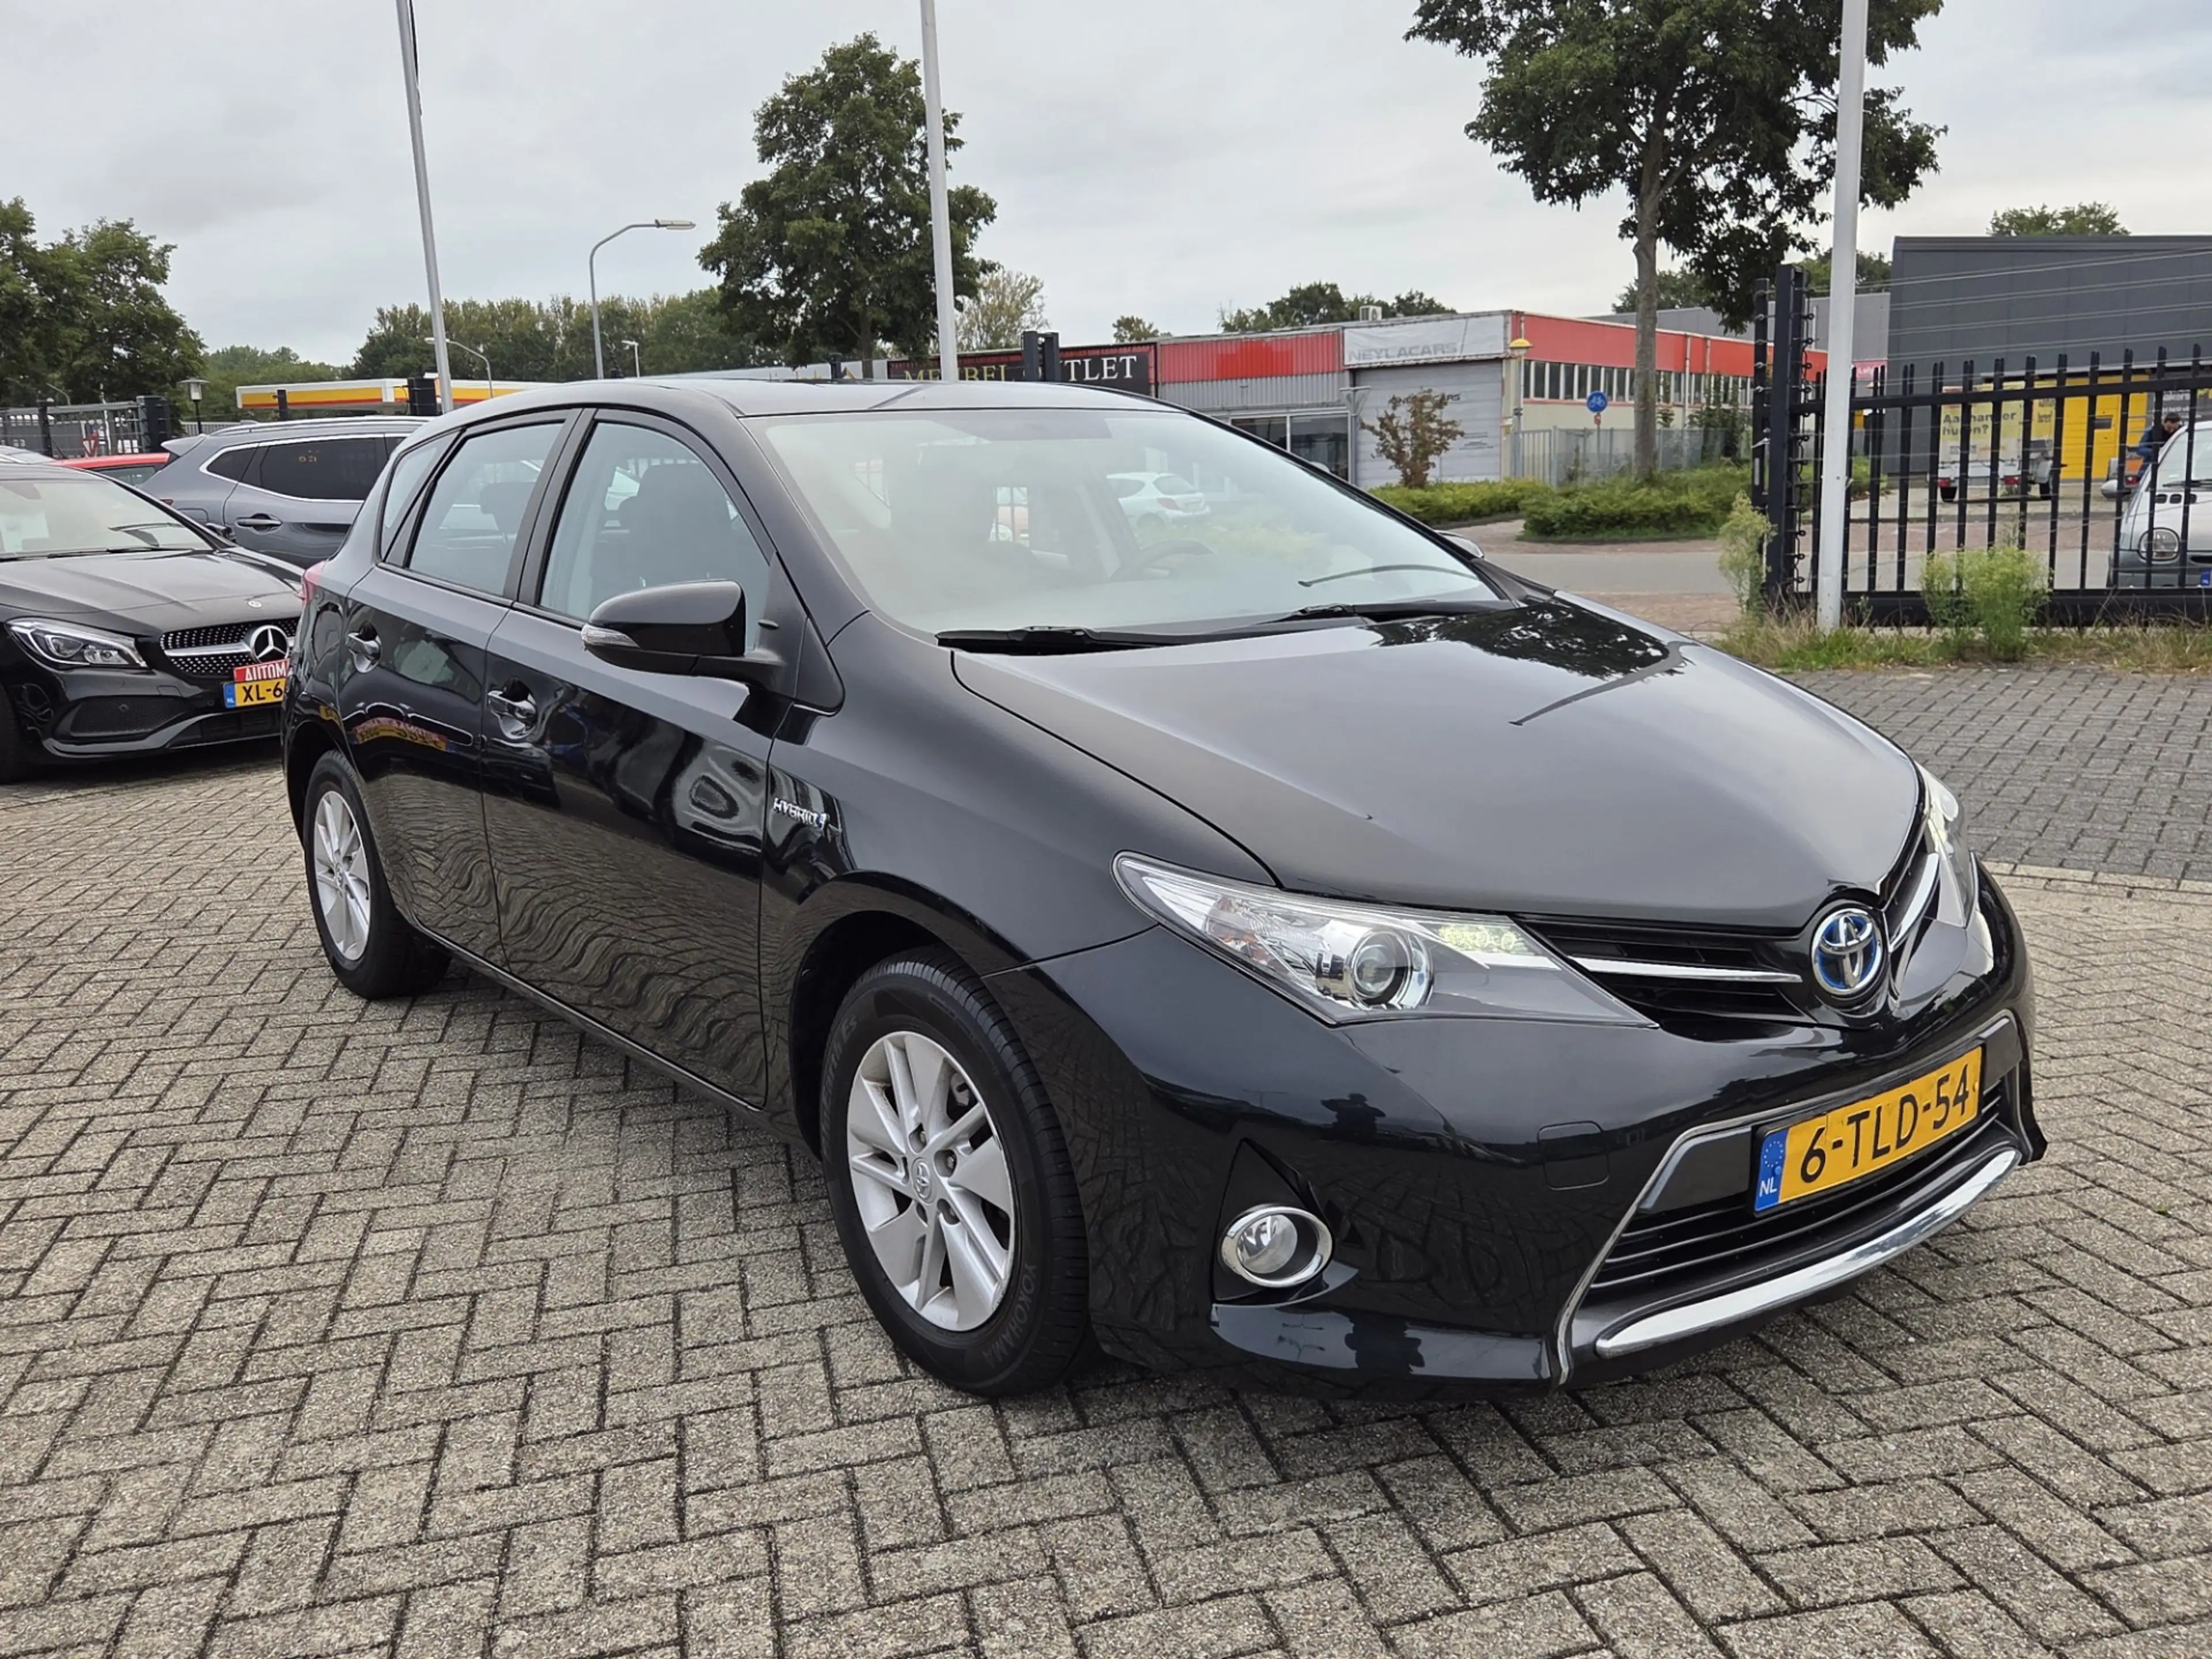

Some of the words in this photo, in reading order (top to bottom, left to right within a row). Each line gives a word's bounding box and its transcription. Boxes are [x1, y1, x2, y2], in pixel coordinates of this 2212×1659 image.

[904, 364, 1007, 381] MEBEL
[1800, 1063, 1969, 1183] 6-TLD-54
[1759, 1179, 1778, 1198] NL
[982, 1263, 1037, 1369] YOKOHAMA
